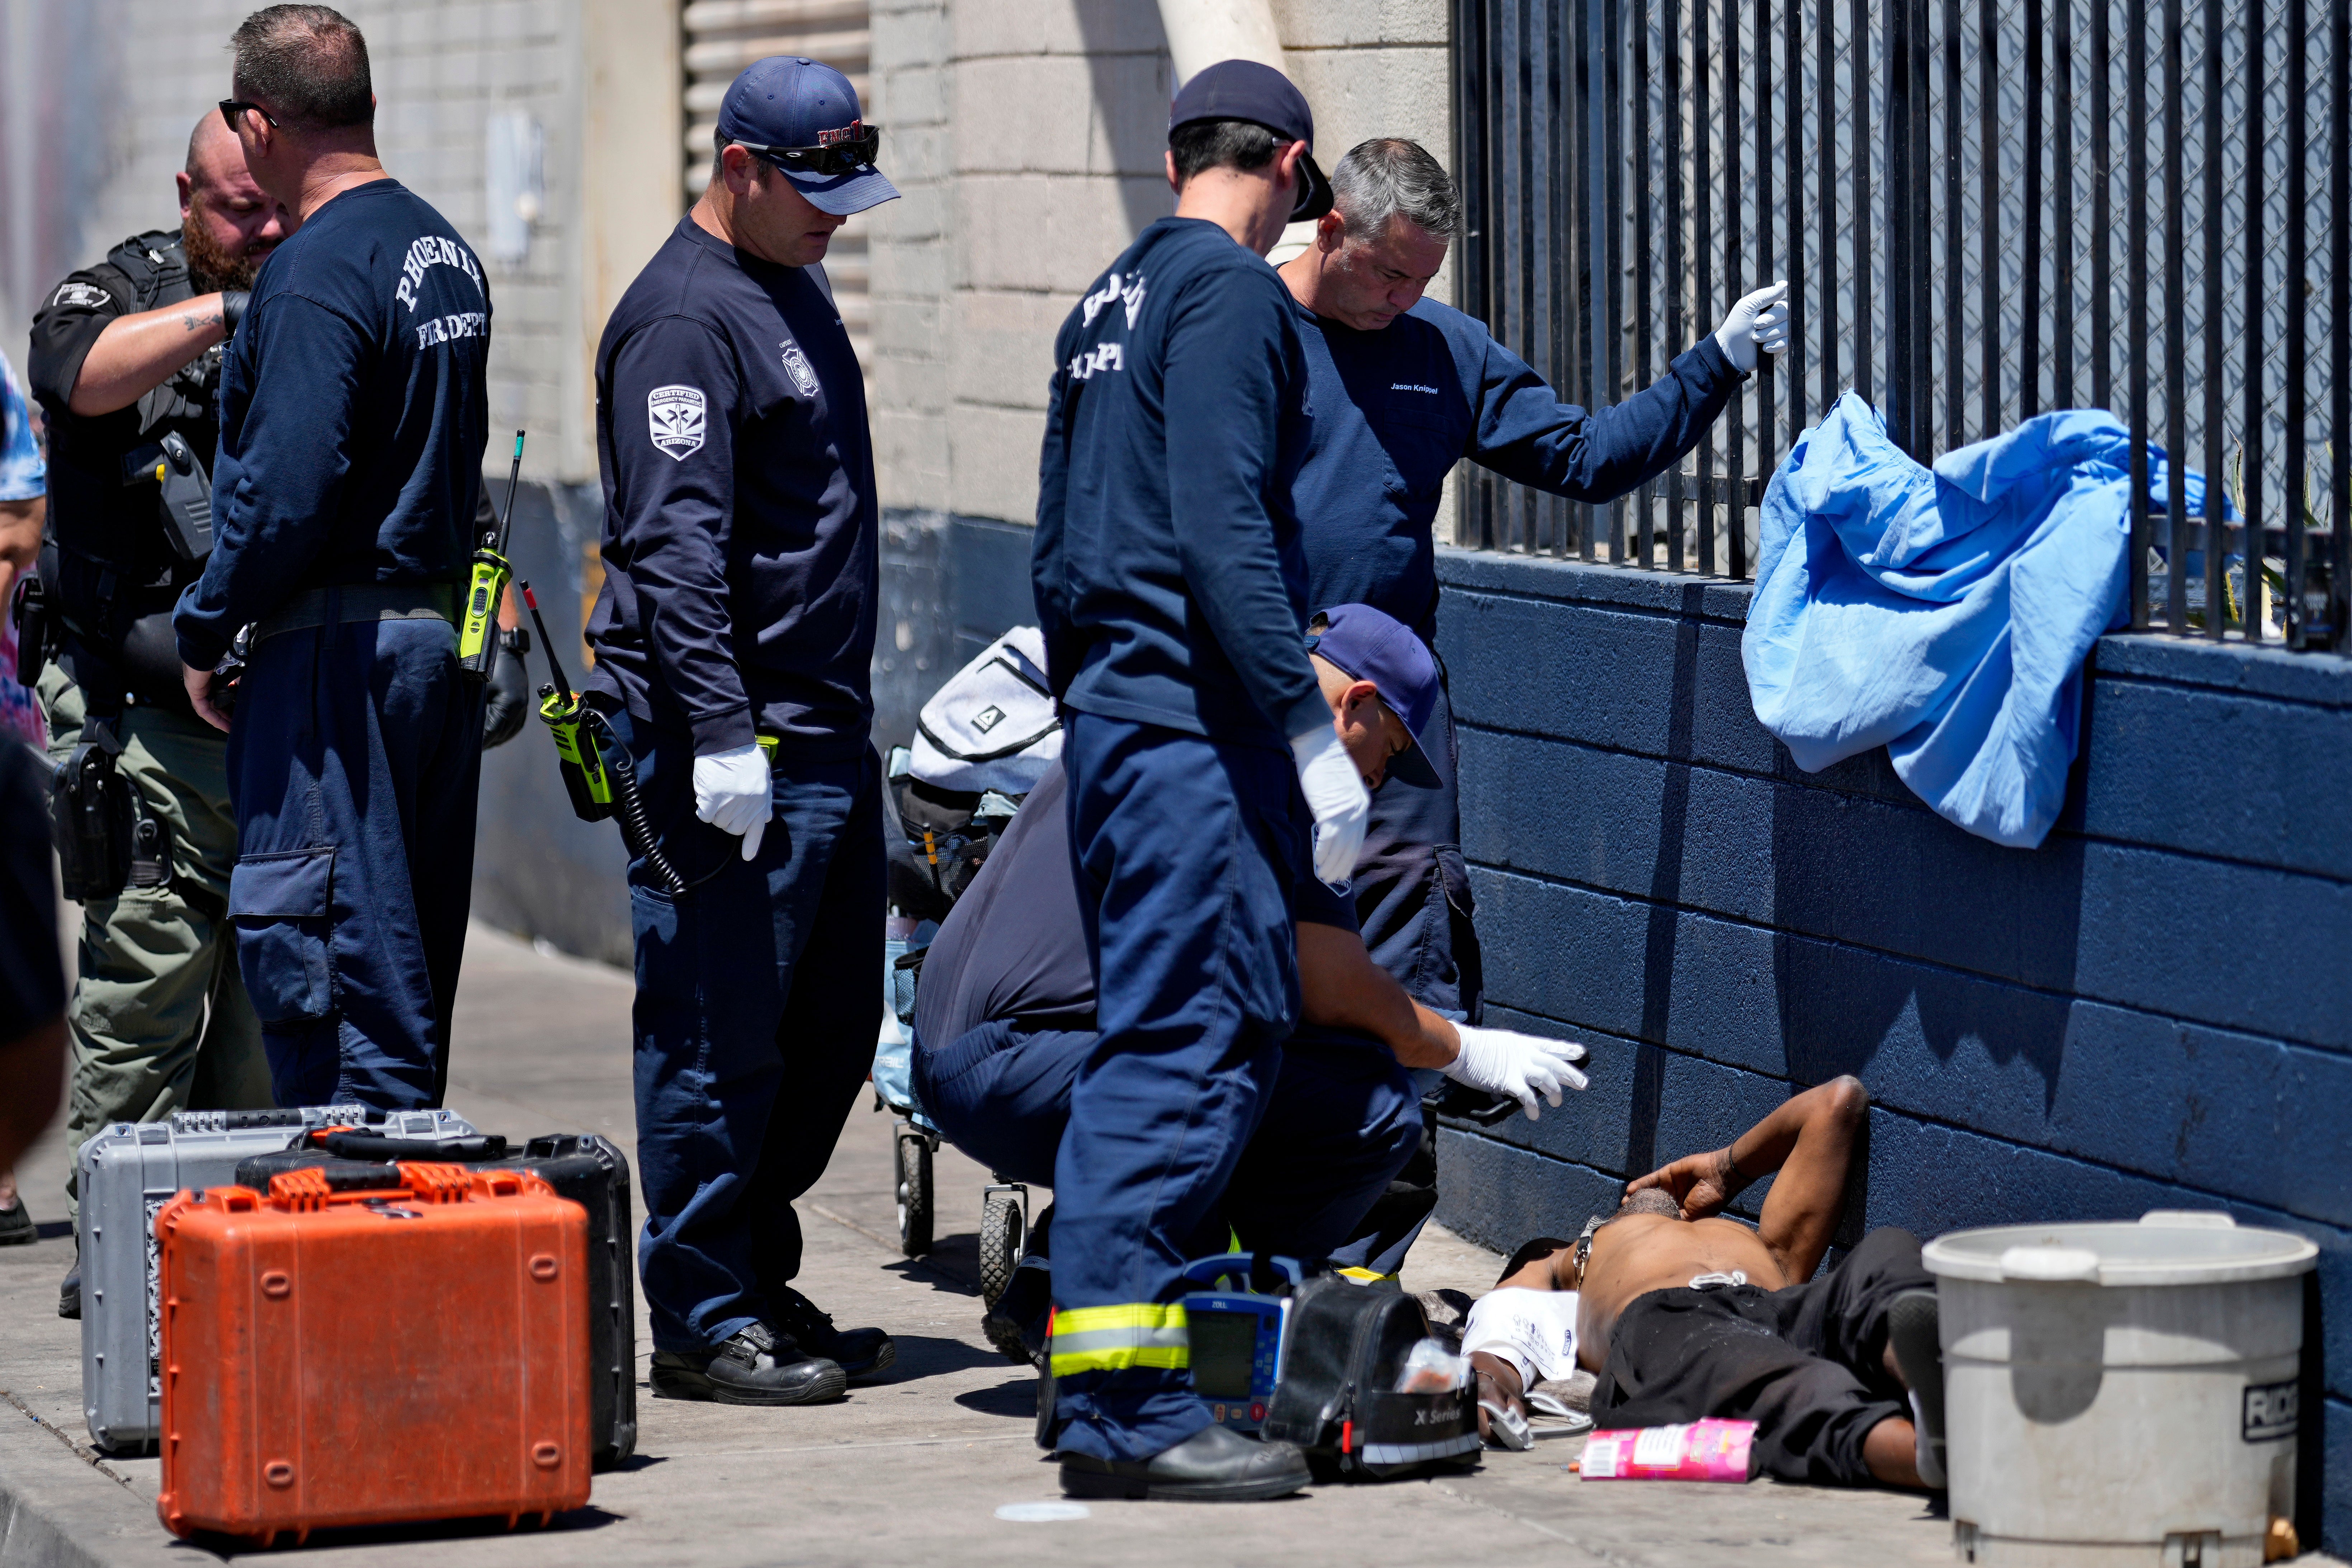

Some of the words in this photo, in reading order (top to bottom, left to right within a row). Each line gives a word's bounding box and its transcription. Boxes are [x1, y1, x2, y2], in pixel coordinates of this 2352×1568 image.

[446, 312, 485, 339] DEPT
[1413, 384, 1438, 394] Knippel
[653, 390, 700, 400] CERTIFIED
[651, 397, 678, 406] EMERGENCY
[679, 397, 702, 407] PARAMEDIC
[660, 438, 696, 447] ARIZONA
[1414, 1409, 1426, 1426] X
[1429, 1407, 1461, 1425] Series
